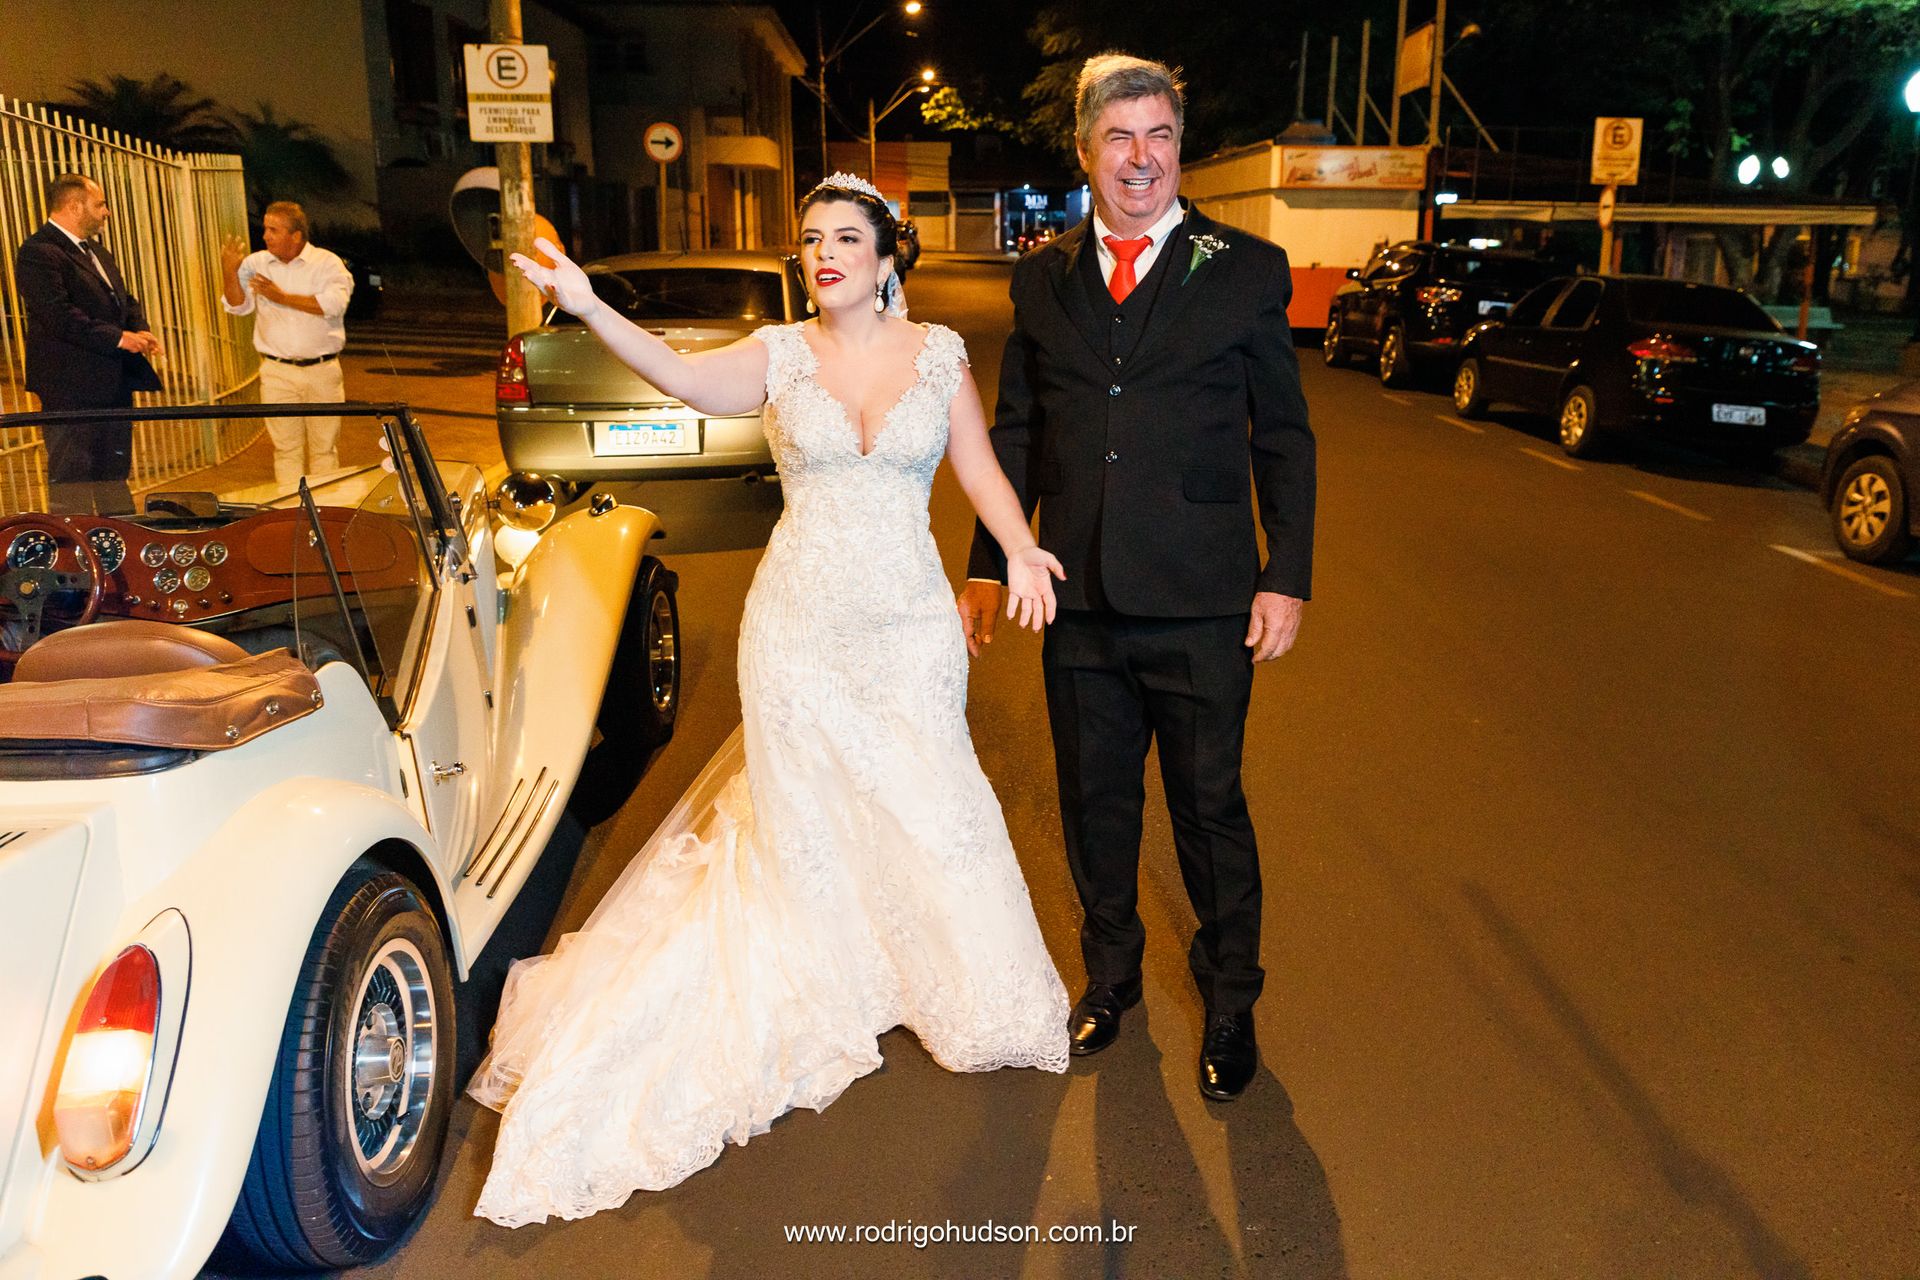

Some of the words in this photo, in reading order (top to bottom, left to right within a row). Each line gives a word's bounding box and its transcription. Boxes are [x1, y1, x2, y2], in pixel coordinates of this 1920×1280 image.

[496, 56, 517, 80] E
[479, 107, 518, 115] PERMITIDO
[521, 107, 541, 116] PARA
[1612, 126, 1625, 144] E
